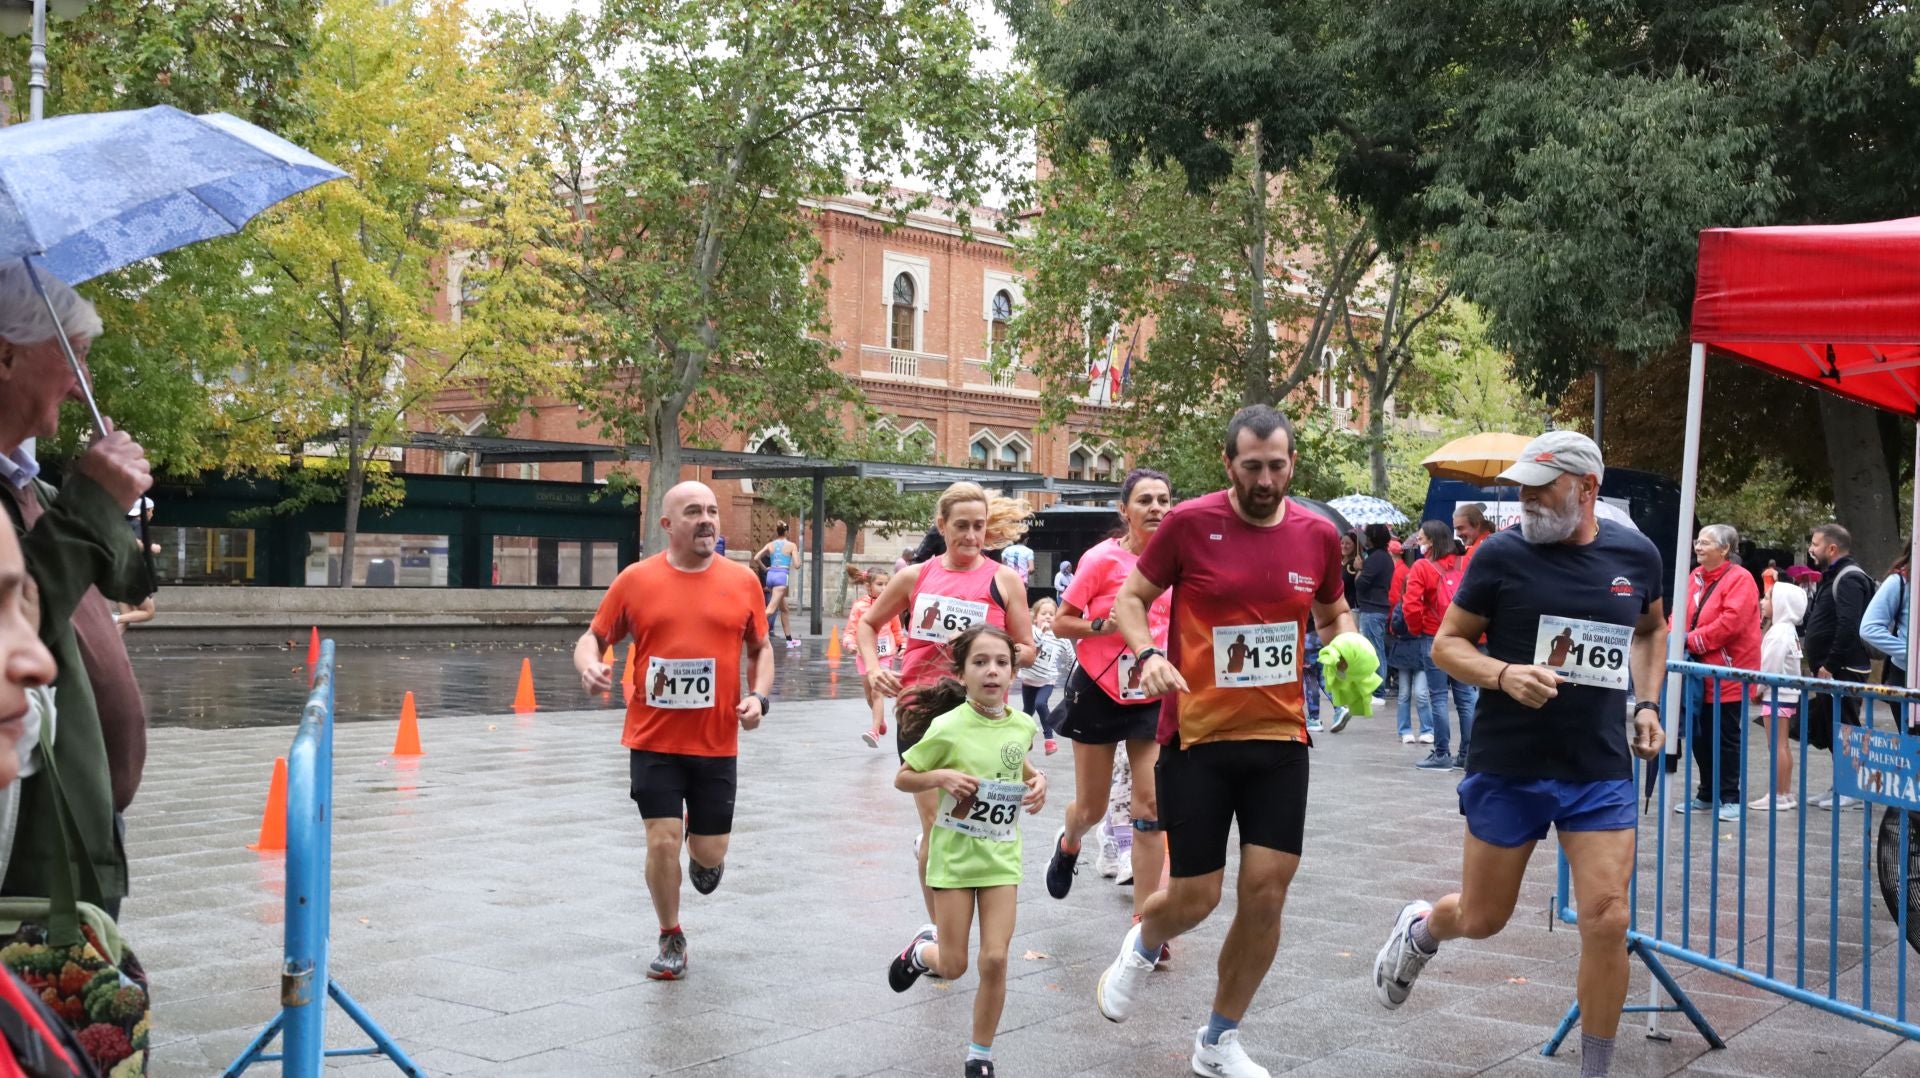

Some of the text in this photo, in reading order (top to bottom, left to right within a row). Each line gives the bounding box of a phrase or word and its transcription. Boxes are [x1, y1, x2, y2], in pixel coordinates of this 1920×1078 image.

[943, 613, 972, 632] 63
[1593, 635, 1603, 643] SIN
[1250, 644, 1293, 669] 136
[1575, 643, 1623, 670] 169
[669, 676, 710, 694] 170
[1869, 751, 1911, 770] PALENCIA
[1857, 766, 1920, 803] OBRA
[970, 800, 1017, 825] 263
